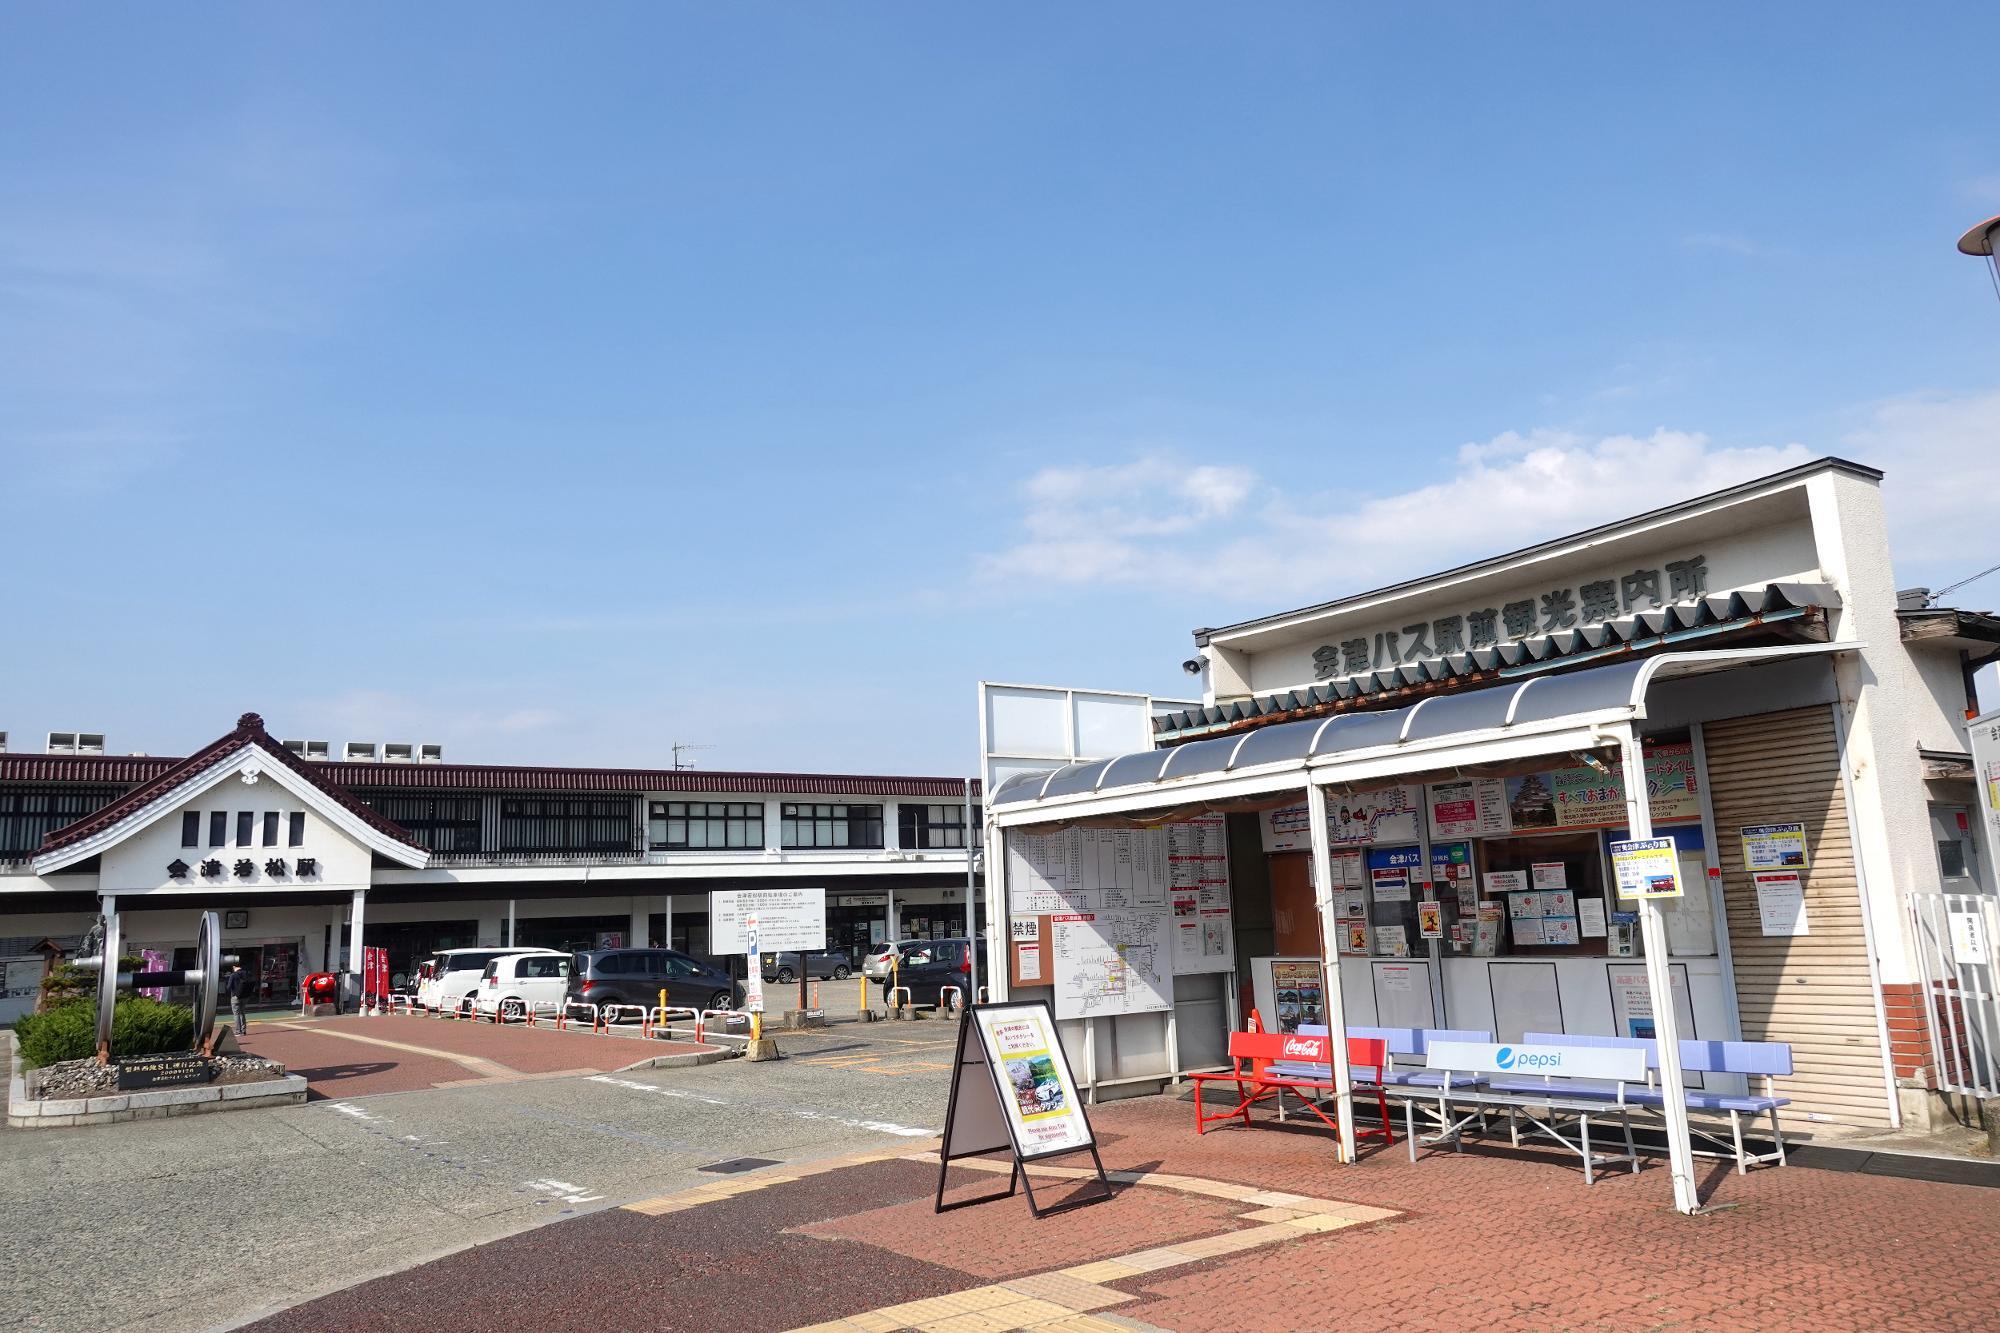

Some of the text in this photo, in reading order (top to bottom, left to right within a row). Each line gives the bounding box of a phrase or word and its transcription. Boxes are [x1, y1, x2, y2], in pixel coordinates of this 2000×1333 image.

[1312, 554, 1709, 680] 会津バス駅前観光案内所
[1389, 854, 1420, 864] 会津バス
[167, 858, 316, 879] 会津若松駅
[1013, 921, 1037, 936] 禁煙
[1285, 1038, 1321, 1056] Coca-Cola
[1518, 1051, 1561, 1068] pepsi
